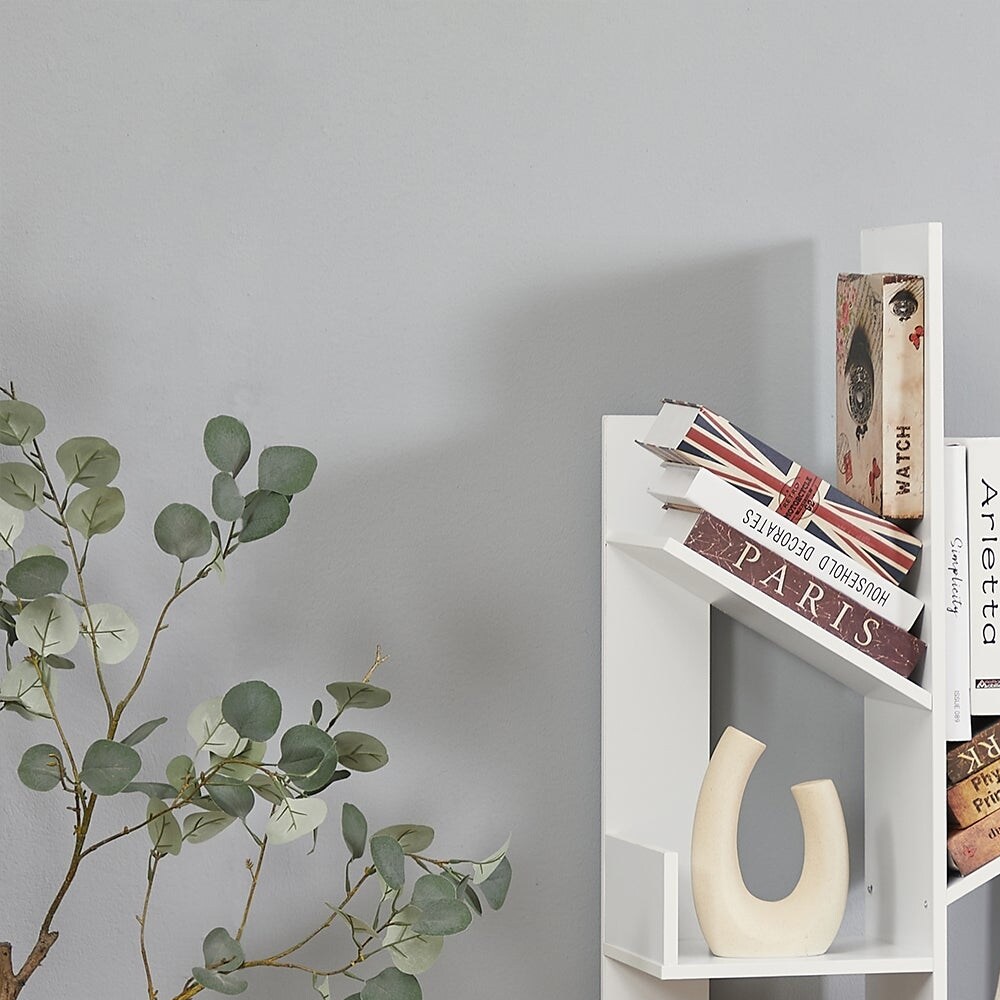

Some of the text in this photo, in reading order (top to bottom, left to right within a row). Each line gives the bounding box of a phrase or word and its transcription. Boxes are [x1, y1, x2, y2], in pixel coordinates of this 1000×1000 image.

[895, 425, 911, 495] WATCH
[732, 541, 881, 647] PARIS
[742, 508, 891, 607] HOUSEHOLD DECORATES
[948, 537, 964, 615] Simplicity
